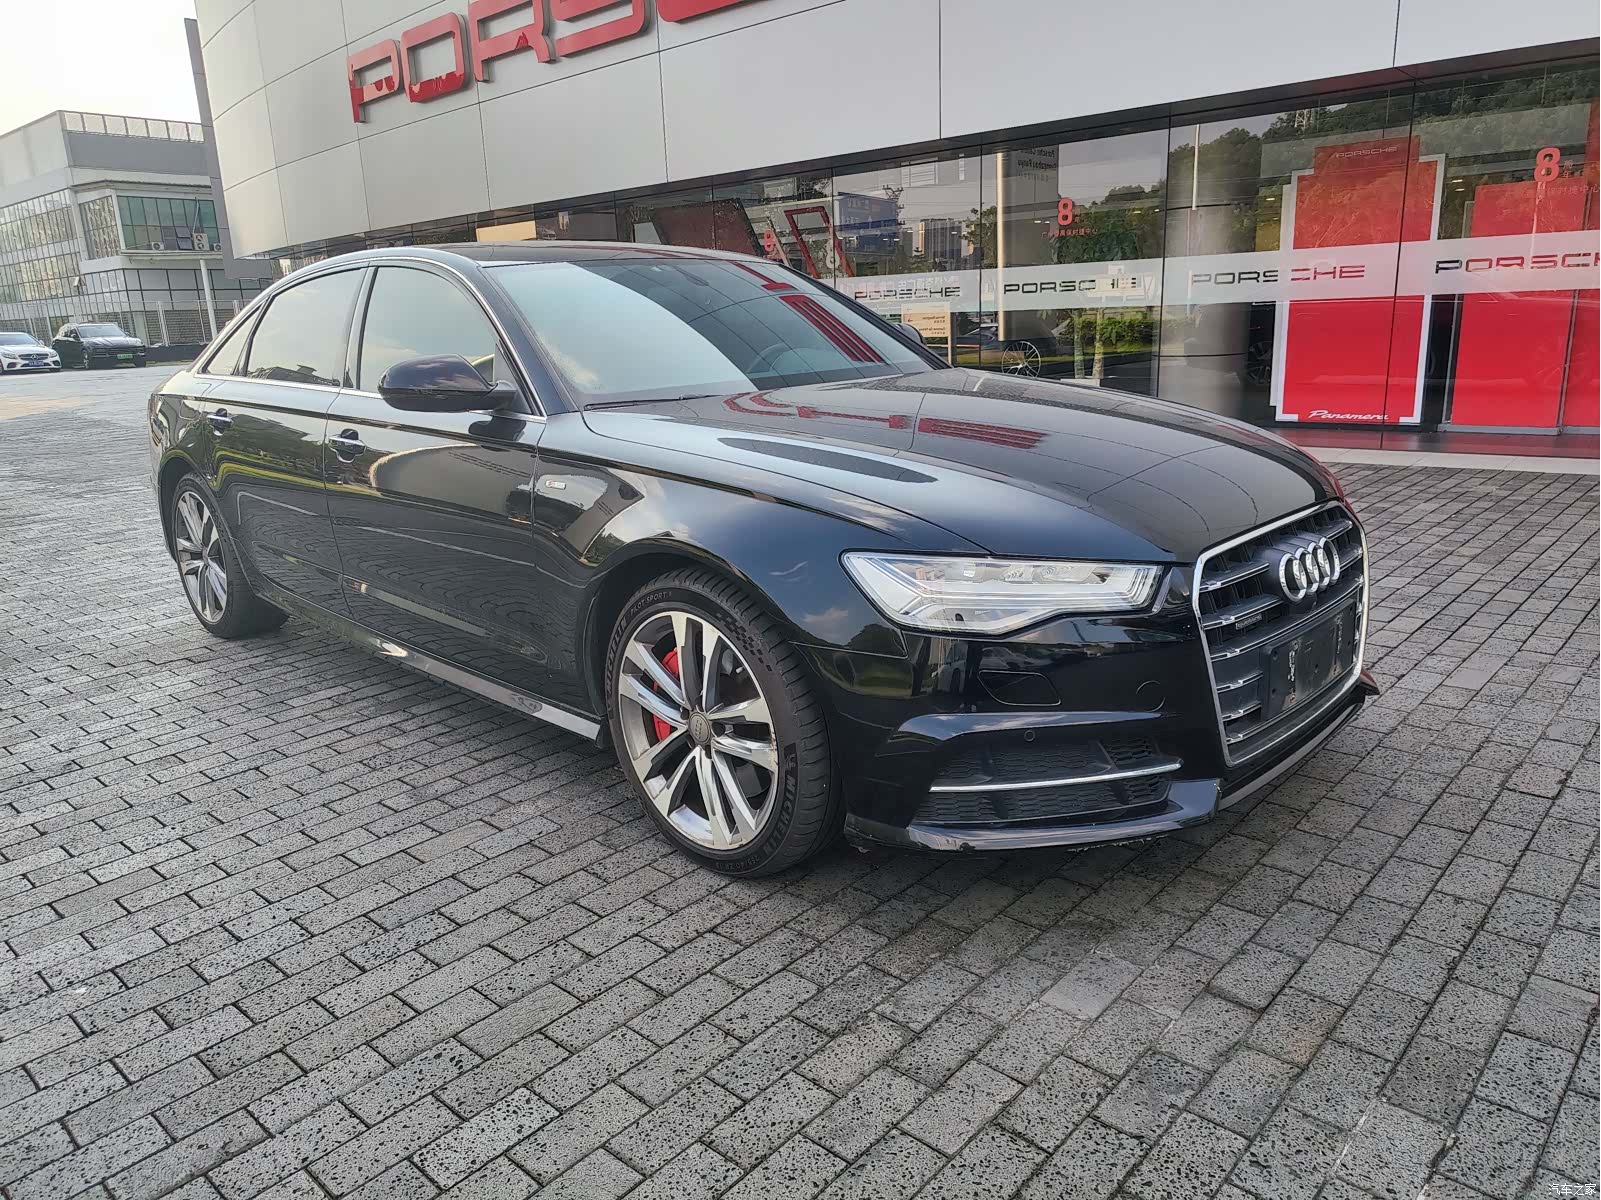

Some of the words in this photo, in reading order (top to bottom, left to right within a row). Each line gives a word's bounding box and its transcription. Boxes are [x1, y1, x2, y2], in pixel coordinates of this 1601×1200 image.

[347, 0, 751, 123] PORS
[1335, 146, 1398, 158] PORSCHE
[1534, 147, 1560, 182] 8
[1057, 197, 1073, 226] 8
[1435, 252, 1600, 274] PORSC
[1308, 409, 1389, 420] Panamera
[630, 599, 645, 616] PILOT
[646, 591, 668, 604] SPORT
[606, 616, 628, 696] MICHELIN
[763, 774, 796, 857] MICHELIN
